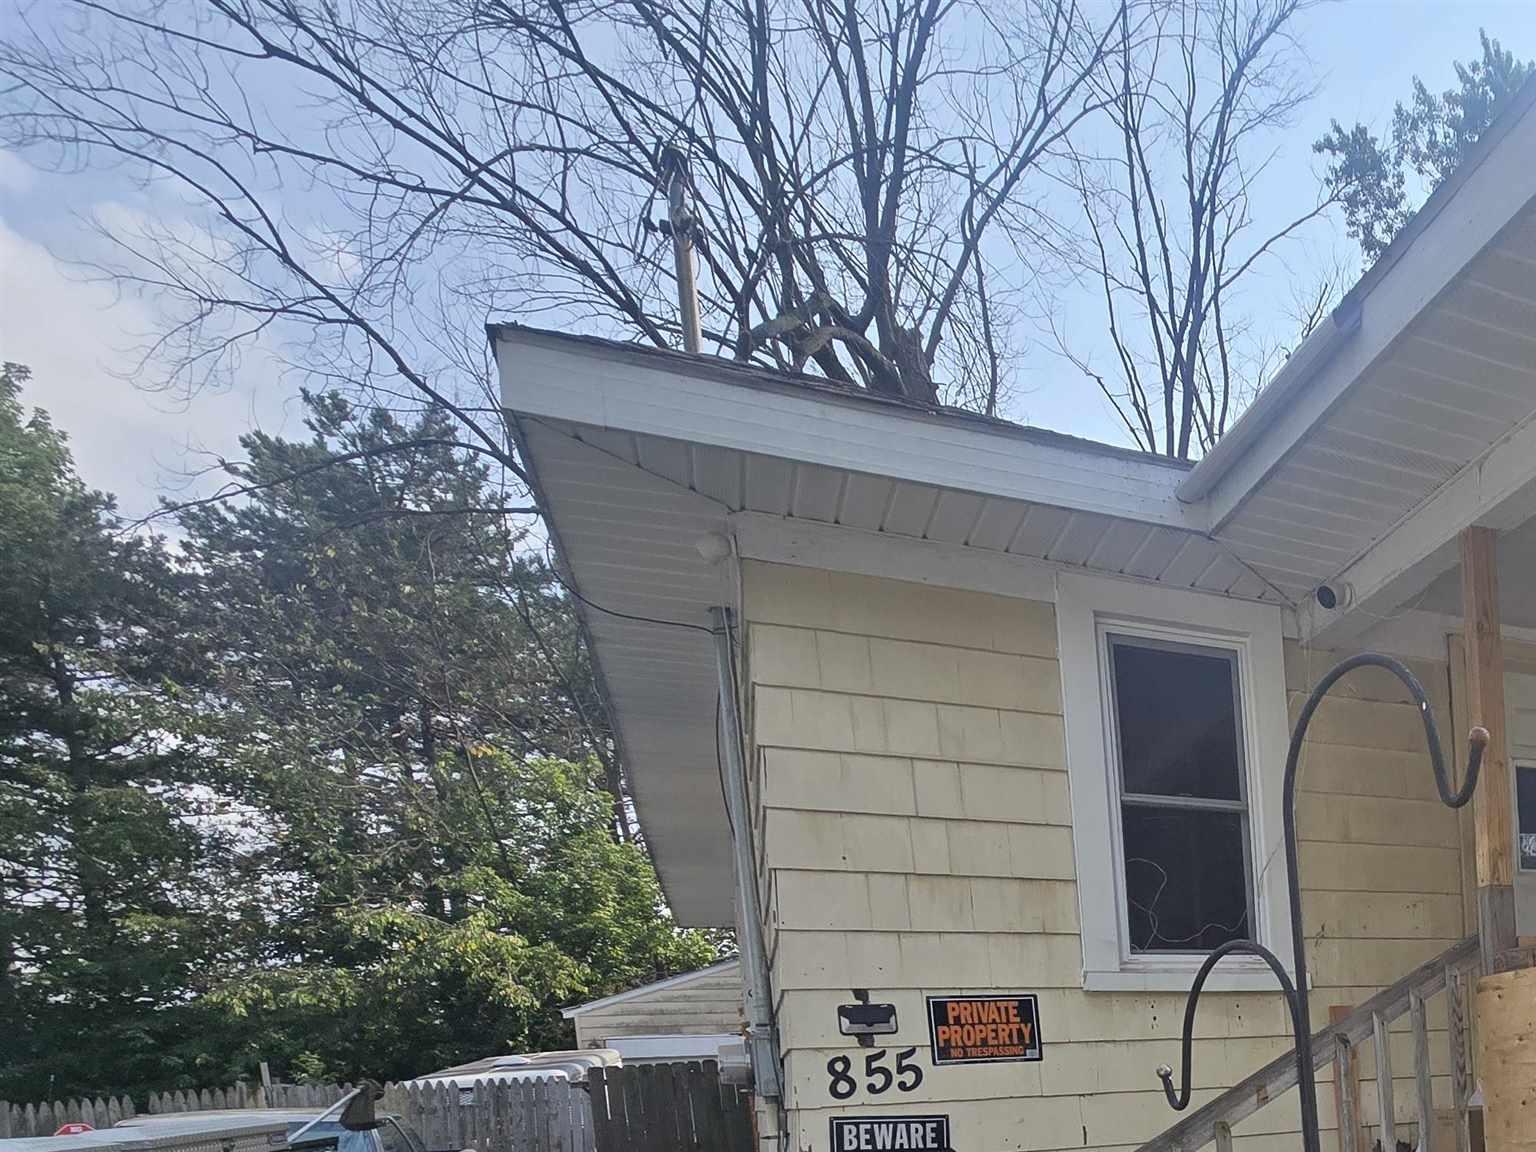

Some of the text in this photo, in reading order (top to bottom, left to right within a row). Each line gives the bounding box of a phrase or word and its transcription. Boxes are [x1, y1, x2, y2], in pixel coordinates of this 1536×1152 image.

[947, 1001, 1020, 1024] PRIVATE
[937, 1022, 1032, 1047] PROPERTY
[950, 1046, 1025, 1058] NO TRESPASSING
[827, 1048, 923, 1100] 855
[843, 1122, 938, 1151] BEWARE
